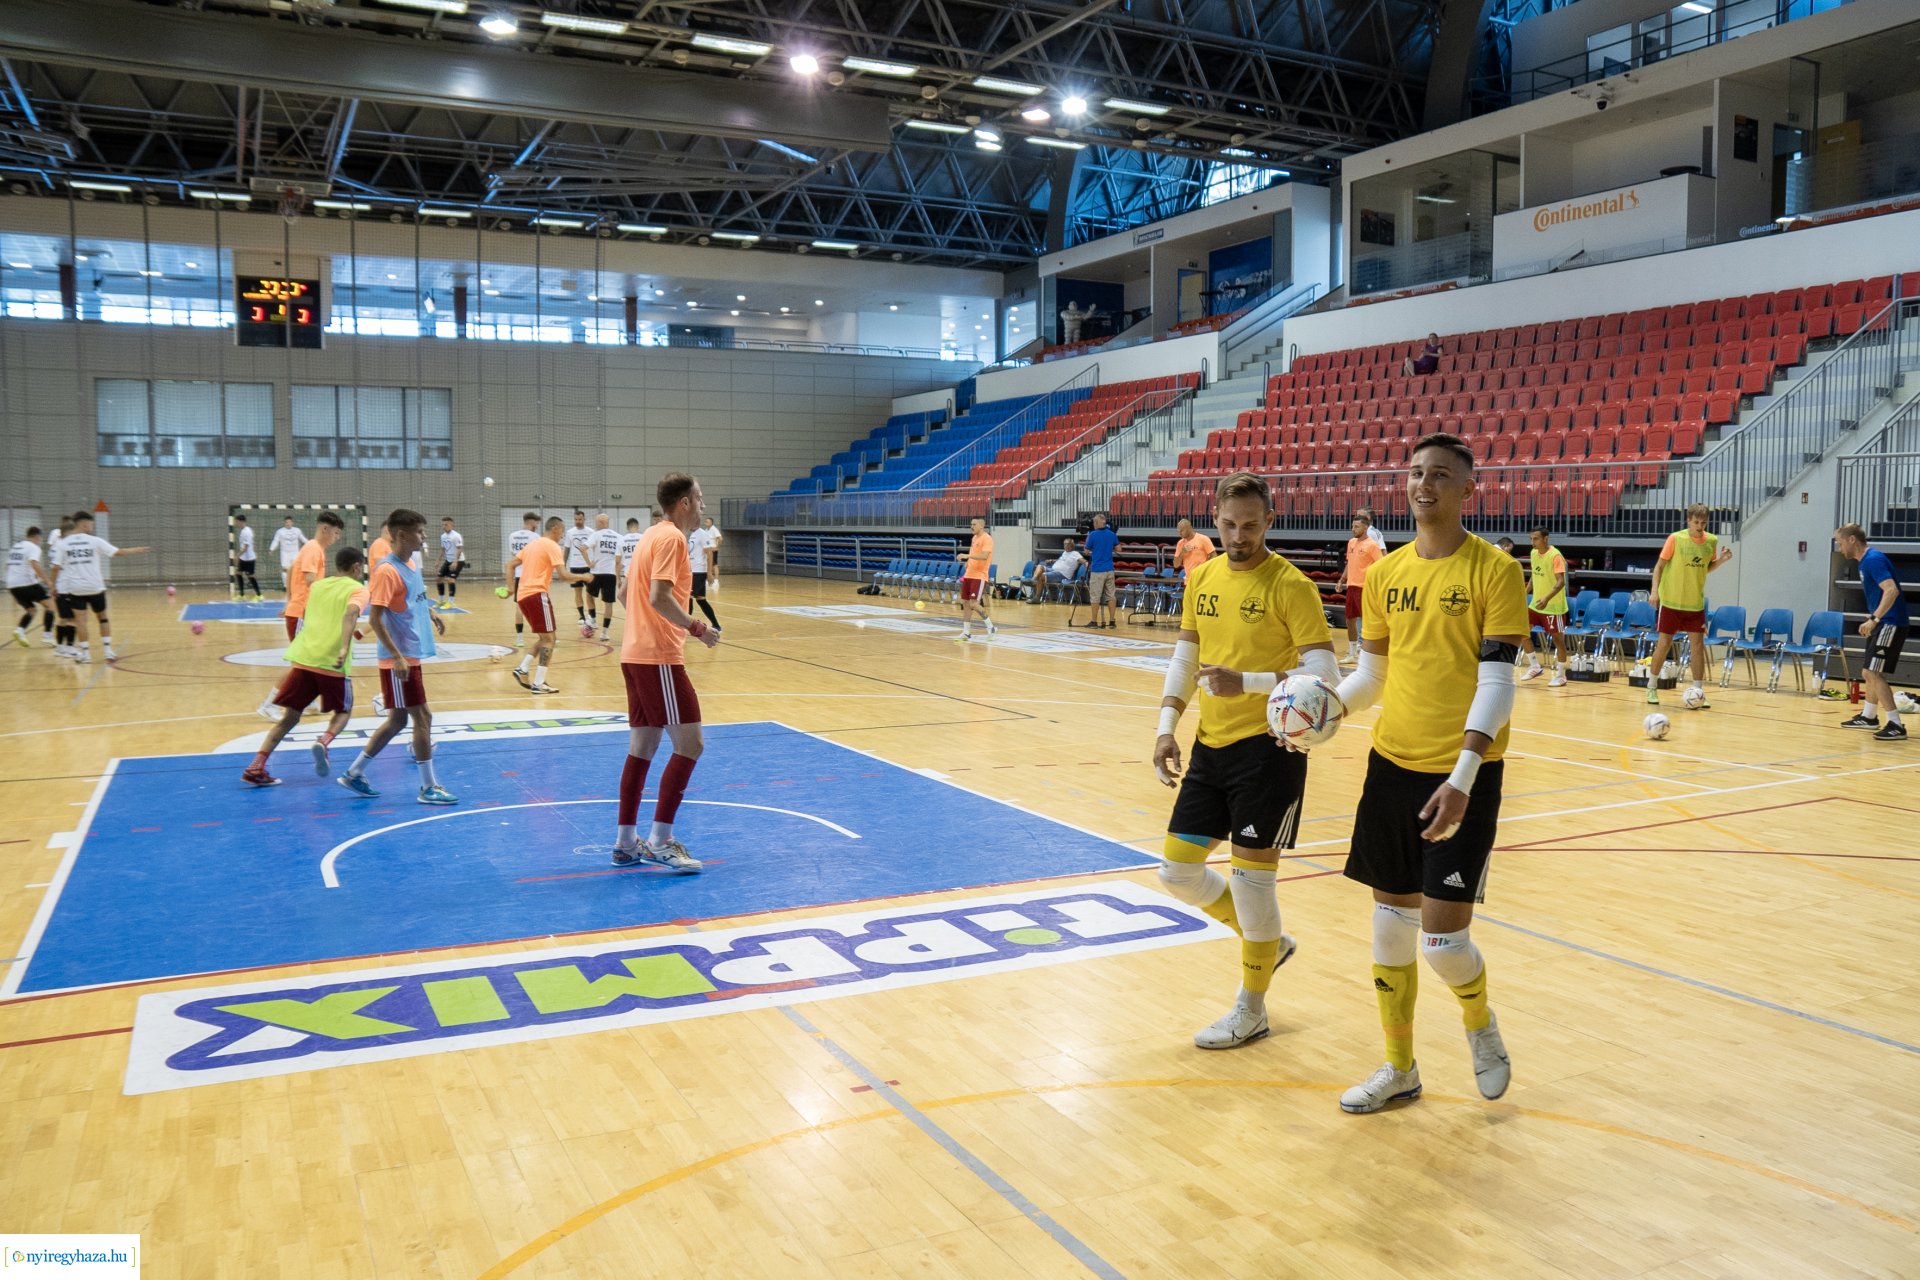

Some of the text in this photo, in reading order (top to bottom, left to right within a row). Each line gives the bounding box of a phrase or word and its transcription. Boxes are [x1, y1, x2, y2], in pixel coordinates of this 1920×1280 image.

[1533, 193, 1624, 232] Continental
[1196, 593, 1219, 618] G.S.
[1386, 586, 1420, 614] P.M.
